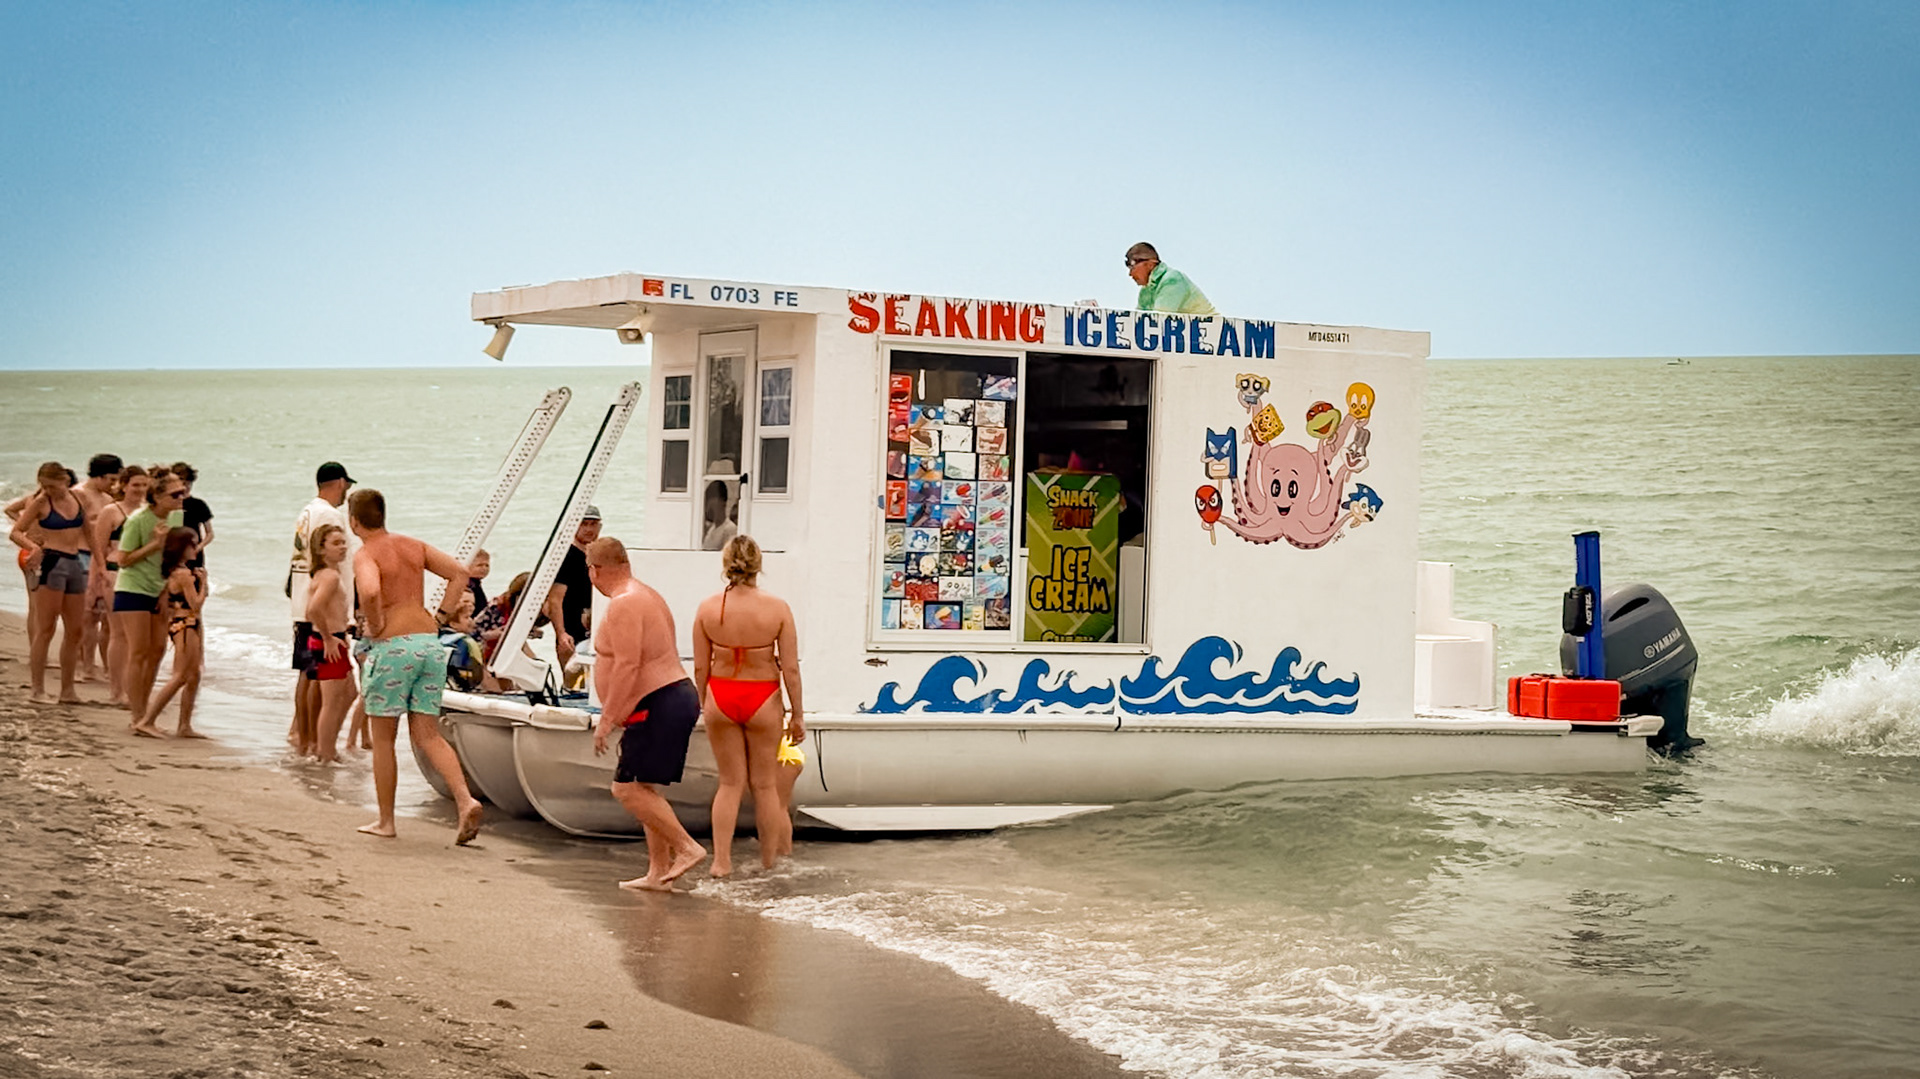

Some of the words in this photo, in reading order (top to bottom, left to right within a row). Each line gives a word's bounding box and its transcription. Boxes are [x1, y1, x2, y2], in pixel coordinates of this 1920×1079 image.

[670, 283, 694, 300] FL
[711, 285, 760, 304] 0703
[774, 290, 799, 307] FE
[848, 290, 1046, 344] SEAKING
[1064, 306, 1276, 359] ICECREAM
[1047, 485, 1099, 508] SNACK
[1051, 544, 1092, 584] ICE
[1029, 576, 1111, 614] CREAM
[1652, 627, 1682, 653] YAMAHA
